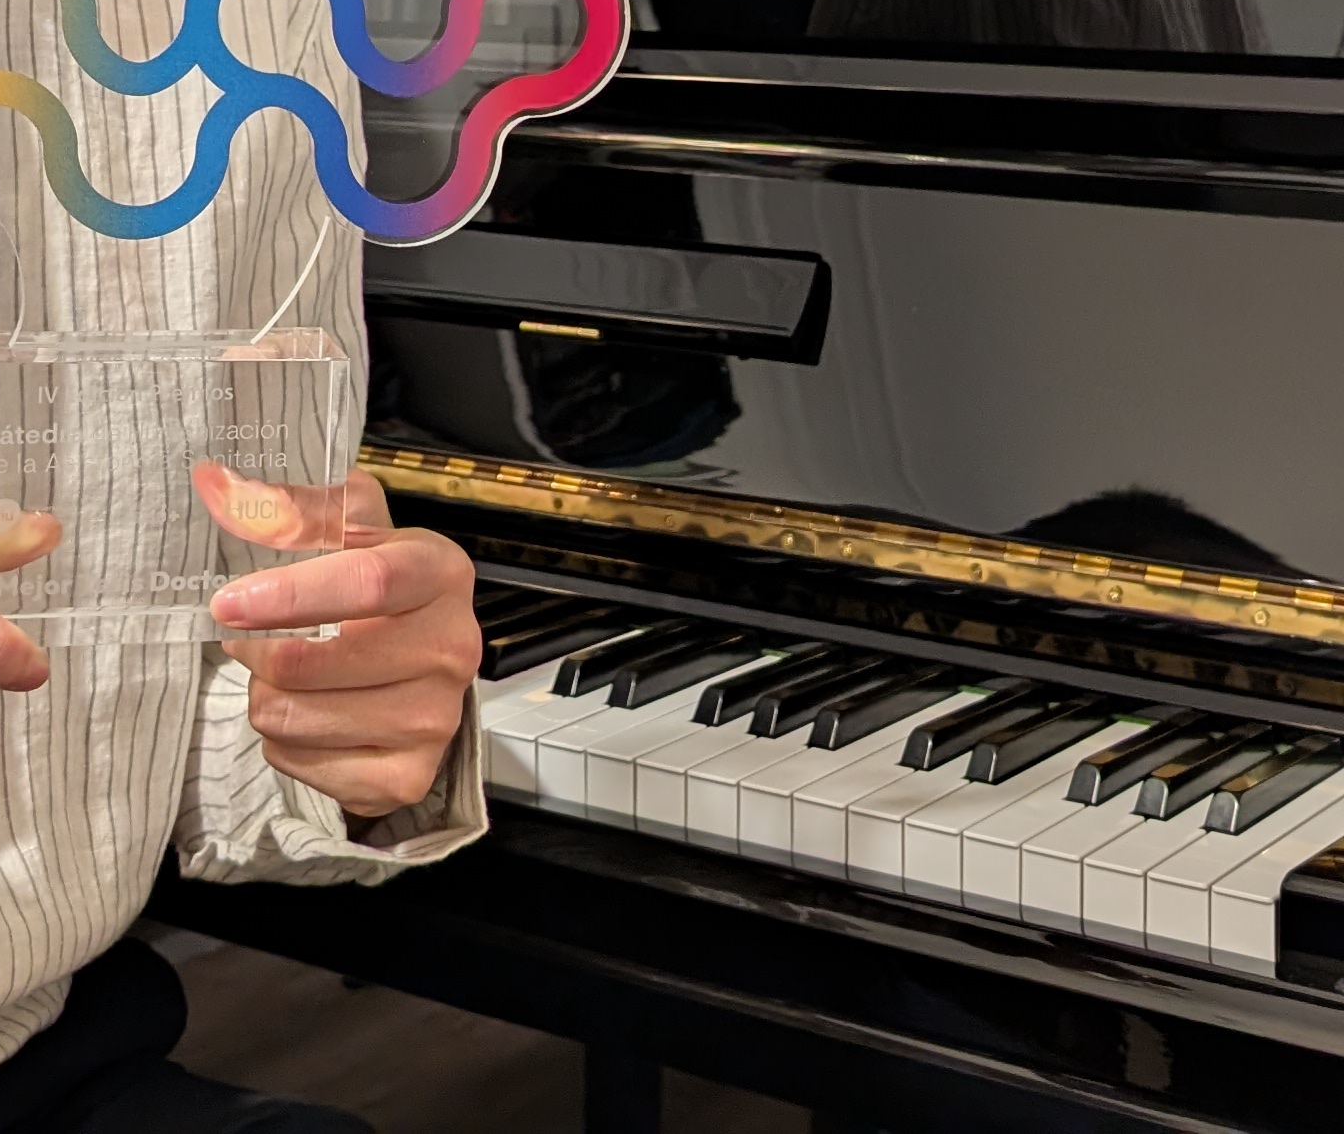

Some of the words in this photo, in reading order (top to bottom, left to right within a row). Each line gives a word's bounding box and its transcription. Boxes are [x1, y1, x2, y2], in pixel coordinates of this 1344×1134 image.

[38, 386, 59, 404] IV
[17, 452, 37, 473] la
[228, 500, 279, 520] HUCI
